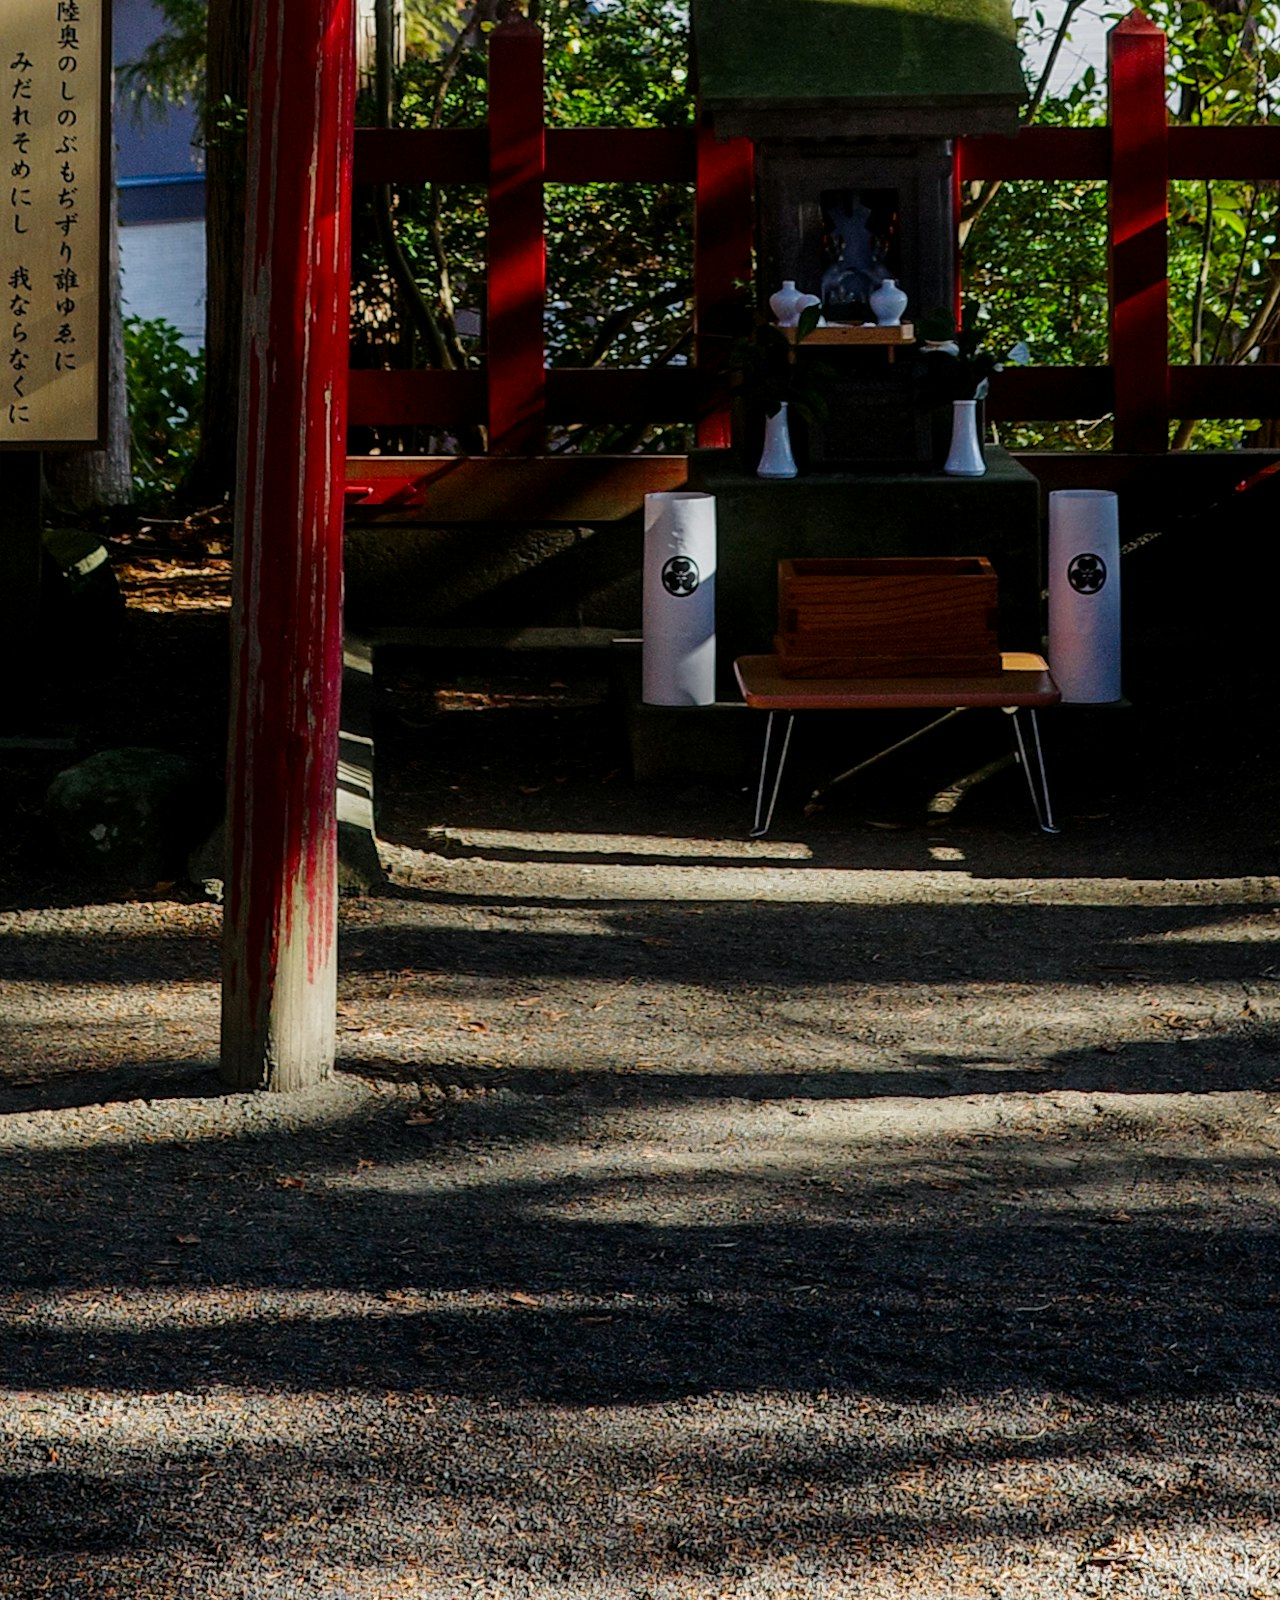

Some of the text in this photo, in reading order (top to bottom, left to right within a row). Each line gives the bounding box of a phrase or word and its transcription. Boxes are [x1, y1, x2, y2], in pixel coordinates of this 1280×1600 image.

[7, 51, 34, 424] みだれそめにし 我ならなくに
[53, 0, 80, 371] 陸奥のしのぶもぢずり誰ゆゑに
